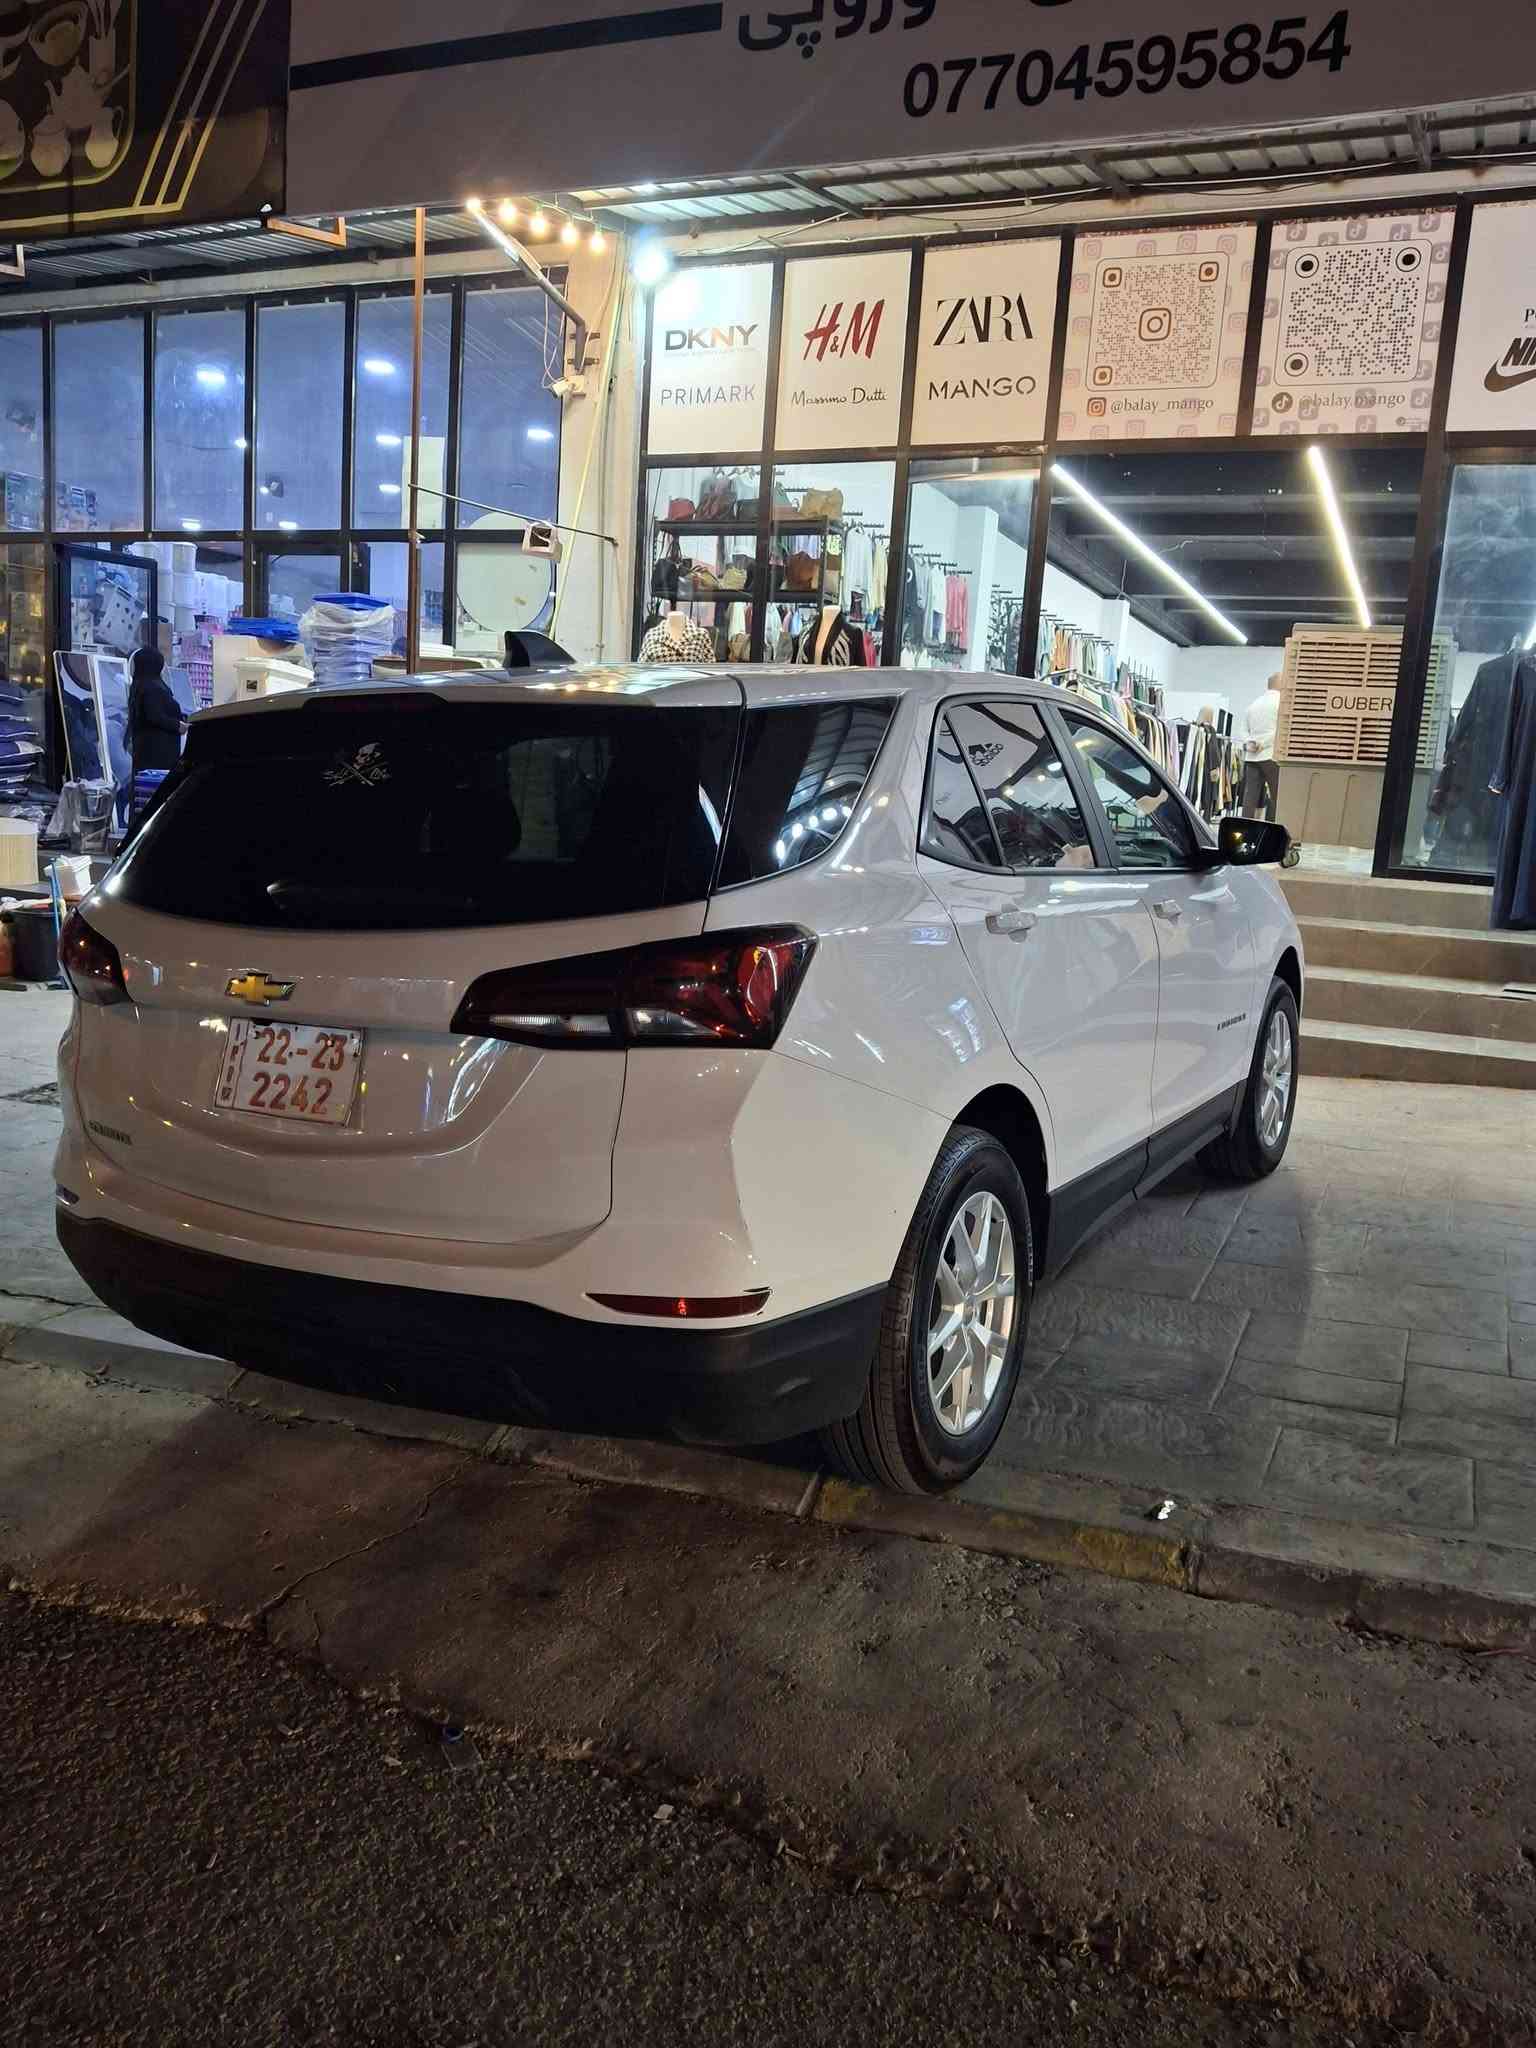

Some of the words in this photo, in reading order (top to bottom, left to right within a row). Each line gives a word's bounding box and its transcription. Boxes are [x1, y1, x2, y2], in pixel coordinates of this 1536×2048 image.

[903, 9, 1352, 118] 07704595854
[803, 299, 885, 362] H&M
[933, 293, 1034, 346] ZARA
[664, 323, 758, 351] DKNY
[661, 384, 756, 406] PRIMARK
[791, 390, 848, 407] Massimo
[850, 386, 888, 404] Dutti
[928, 375, 1037, 401] MANGO
[1111, 395, 1214, 414] @balay_mango
[1330, 695, 1393, 711] OUBER
[256, 1027, 348, 1071] 22-23
[247, 1071, 333, 1115] 2242
